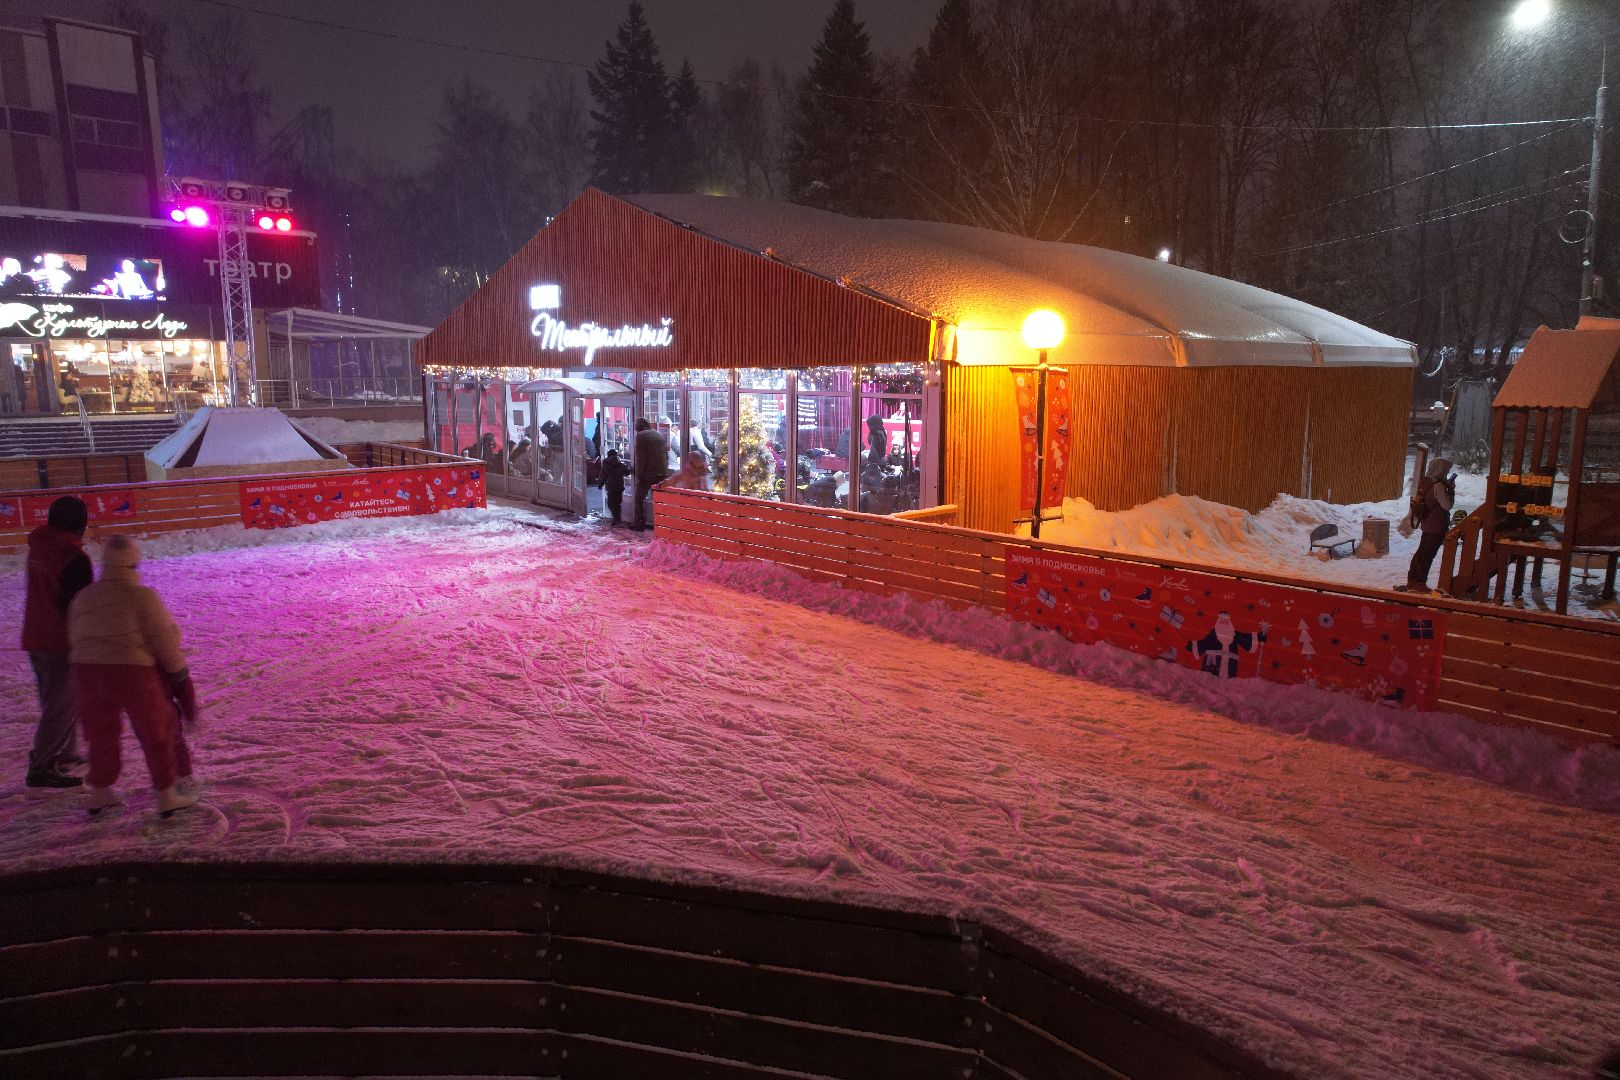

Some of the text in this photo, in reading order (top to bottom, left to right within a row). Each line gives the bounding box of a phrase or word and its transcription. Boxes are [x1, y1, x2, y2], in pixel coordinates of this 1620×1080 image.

[203, 259, 292, 285] театр
[141, 312, 188, 338] Люди
[531, 312, 674, 366] Театральный
[341, 505, 410, 518] УДОВОЛЬСТВИЕМ!
[349, 498, 395, 509] КАТАЙТЕСЬ
[1011, 554, 1034, 563] ЗИМА
[1035, 556, 1042, 564] В
[1042, 558, 1106, 576] ПОДМОСКОВЬЕ
